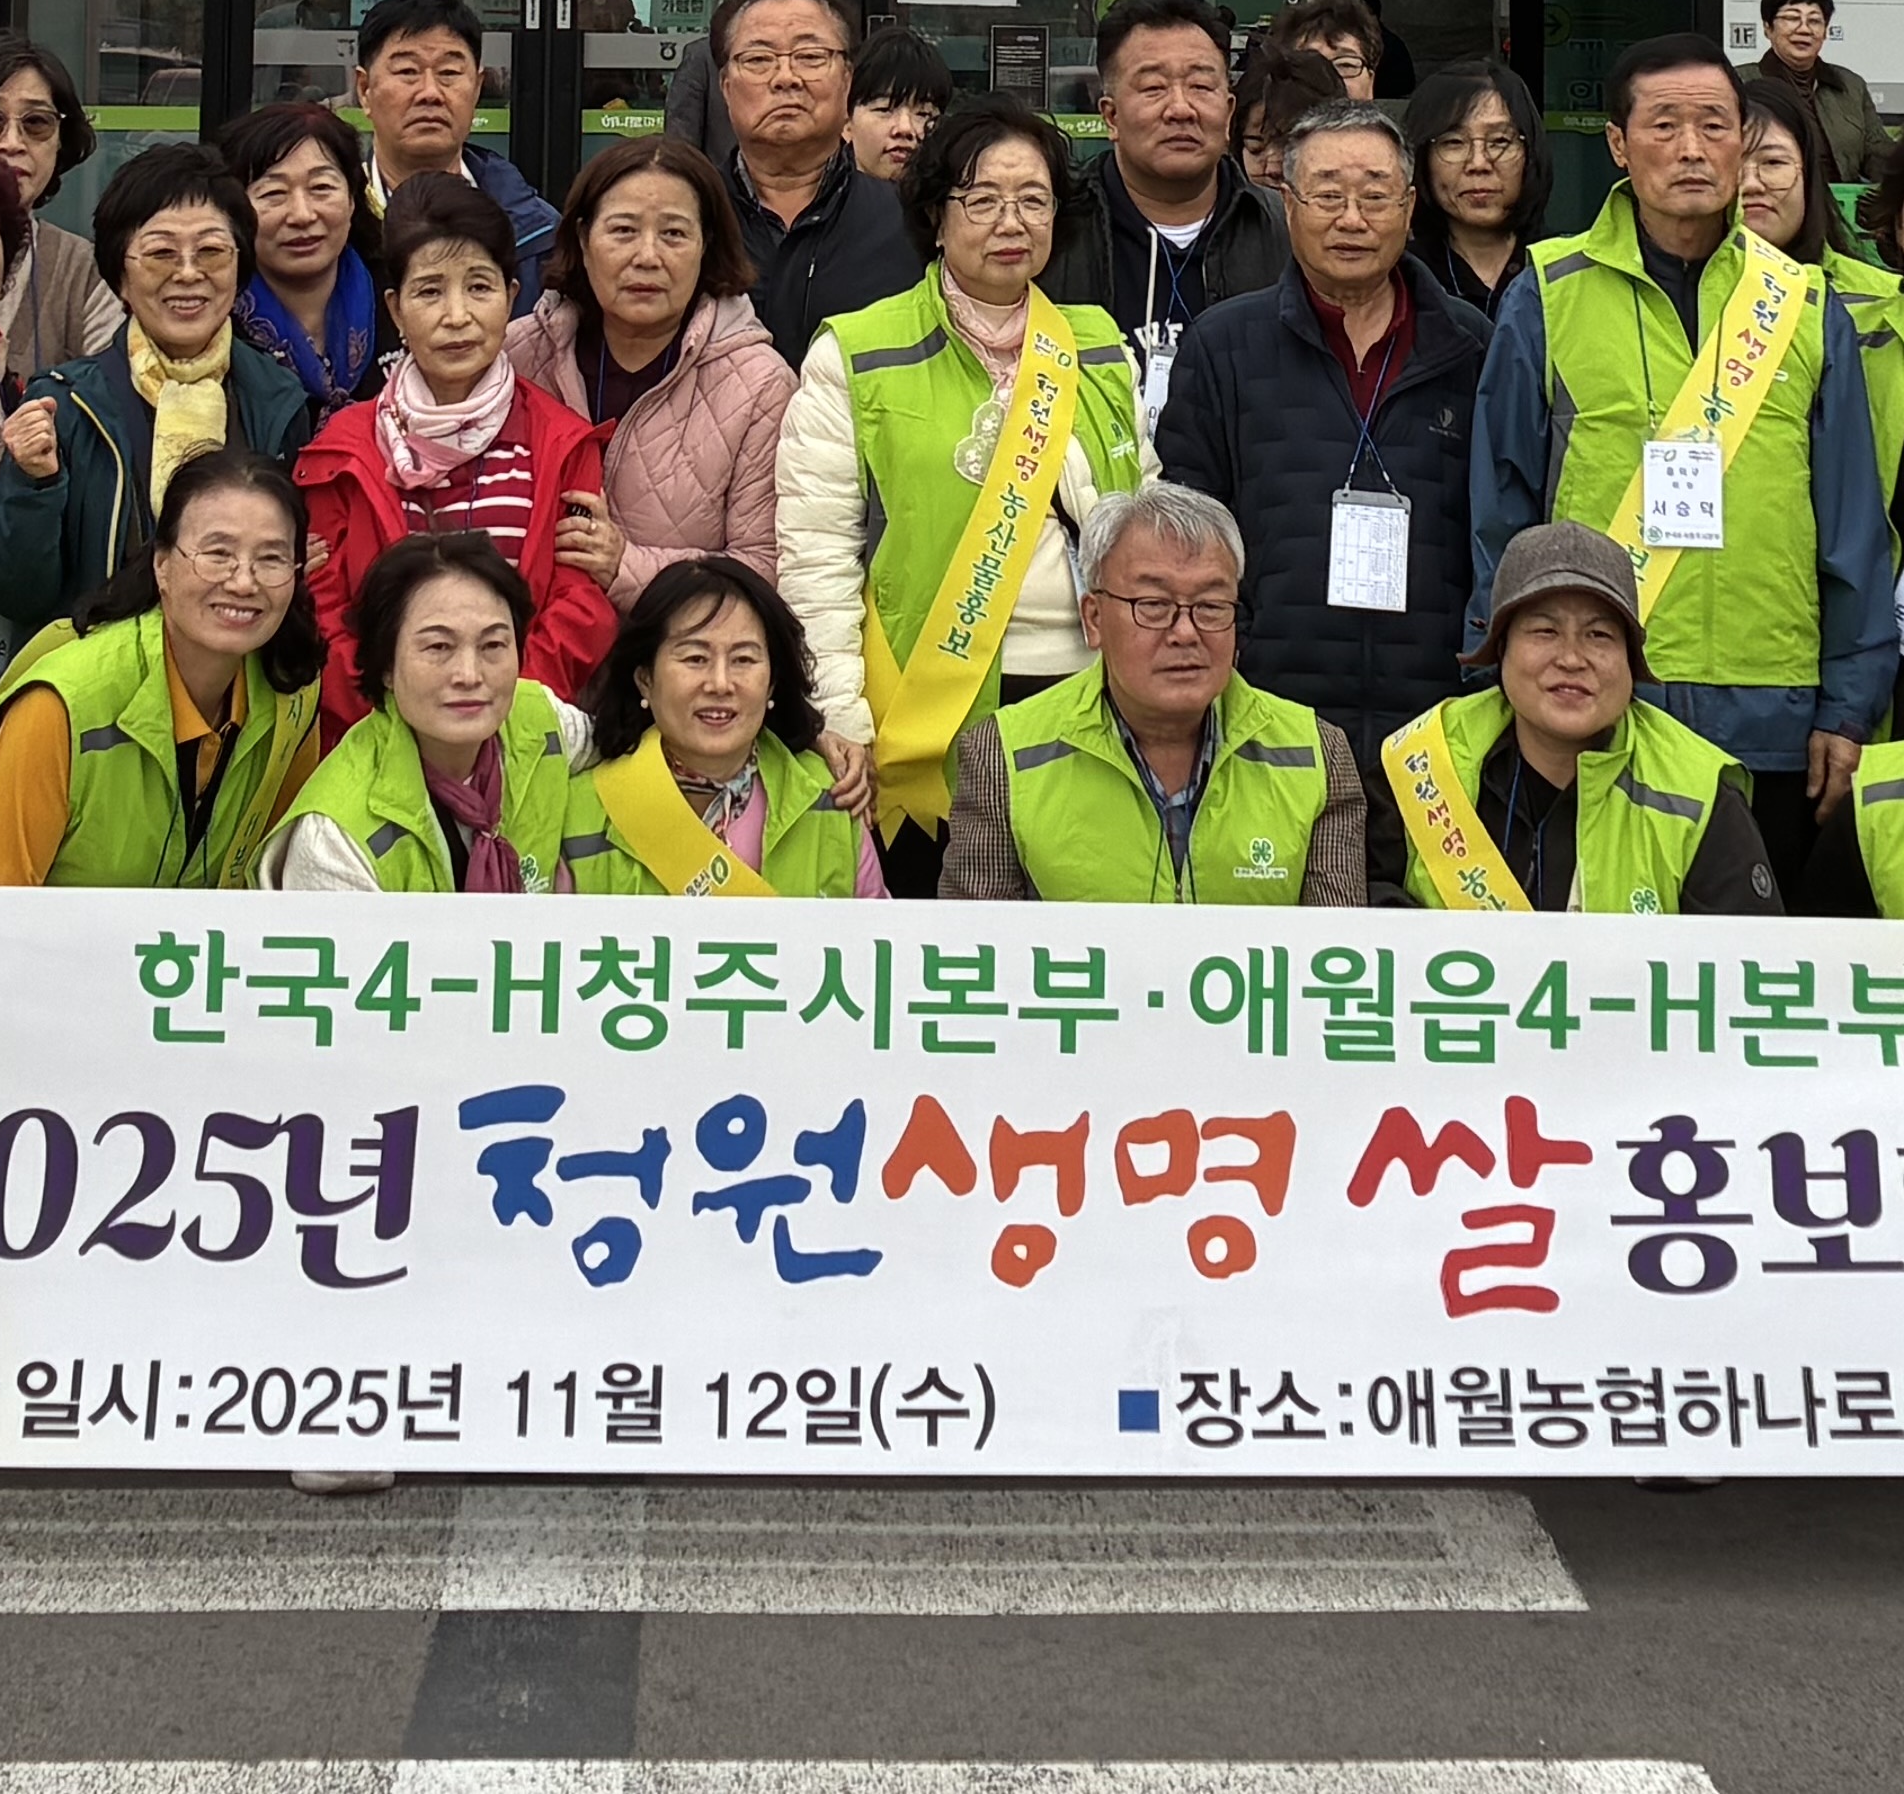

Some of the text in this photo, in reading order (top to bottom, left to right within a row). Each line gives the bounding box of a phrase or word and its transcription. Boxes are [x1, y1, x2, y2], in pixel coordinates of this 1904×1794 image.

[1733, 27, 1755, 44] 1F
[936, 371, 1060, 662] 청원생명 농산물홍보
[458, 1083, 1298, 1289] 청원생명
[1345, 1095, 1593, 1319] 쌀
[503, 1362, 666, 1443] 11월
[703, 1363, 997, 1452] 12일(수)
